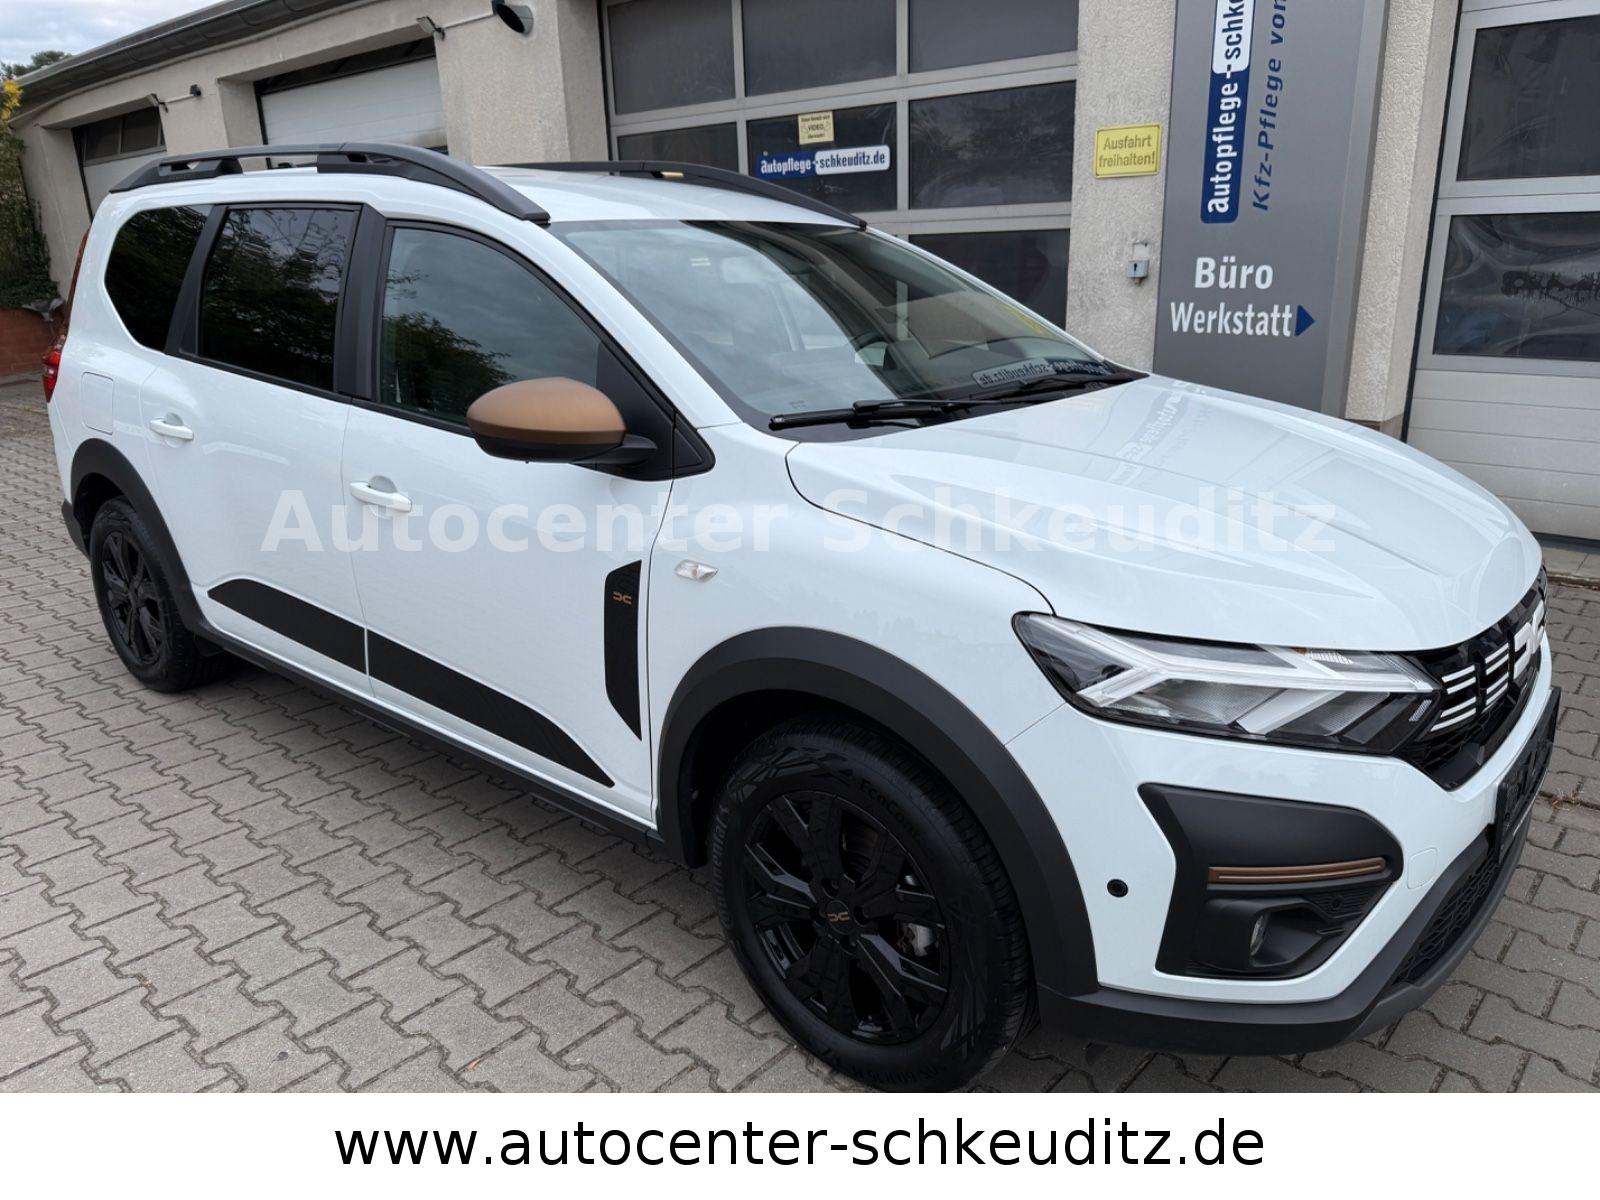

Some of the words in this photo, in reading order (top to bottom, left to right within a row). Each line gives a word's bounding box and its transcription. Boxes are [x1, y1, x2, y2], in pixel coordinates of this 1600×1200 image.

[1104, 135, 1152, 150] Ausfahrt
[1253, 58, 1283, 211] Kfz-Pflege
[761, 150, 886, 175] autopflege-schkeuditz.de
[1099, 151, 1155, 168] freihalten!
[1194, 254, 1275, 291] Büro
[1170, 301, 1292, 338] Werkstatt
